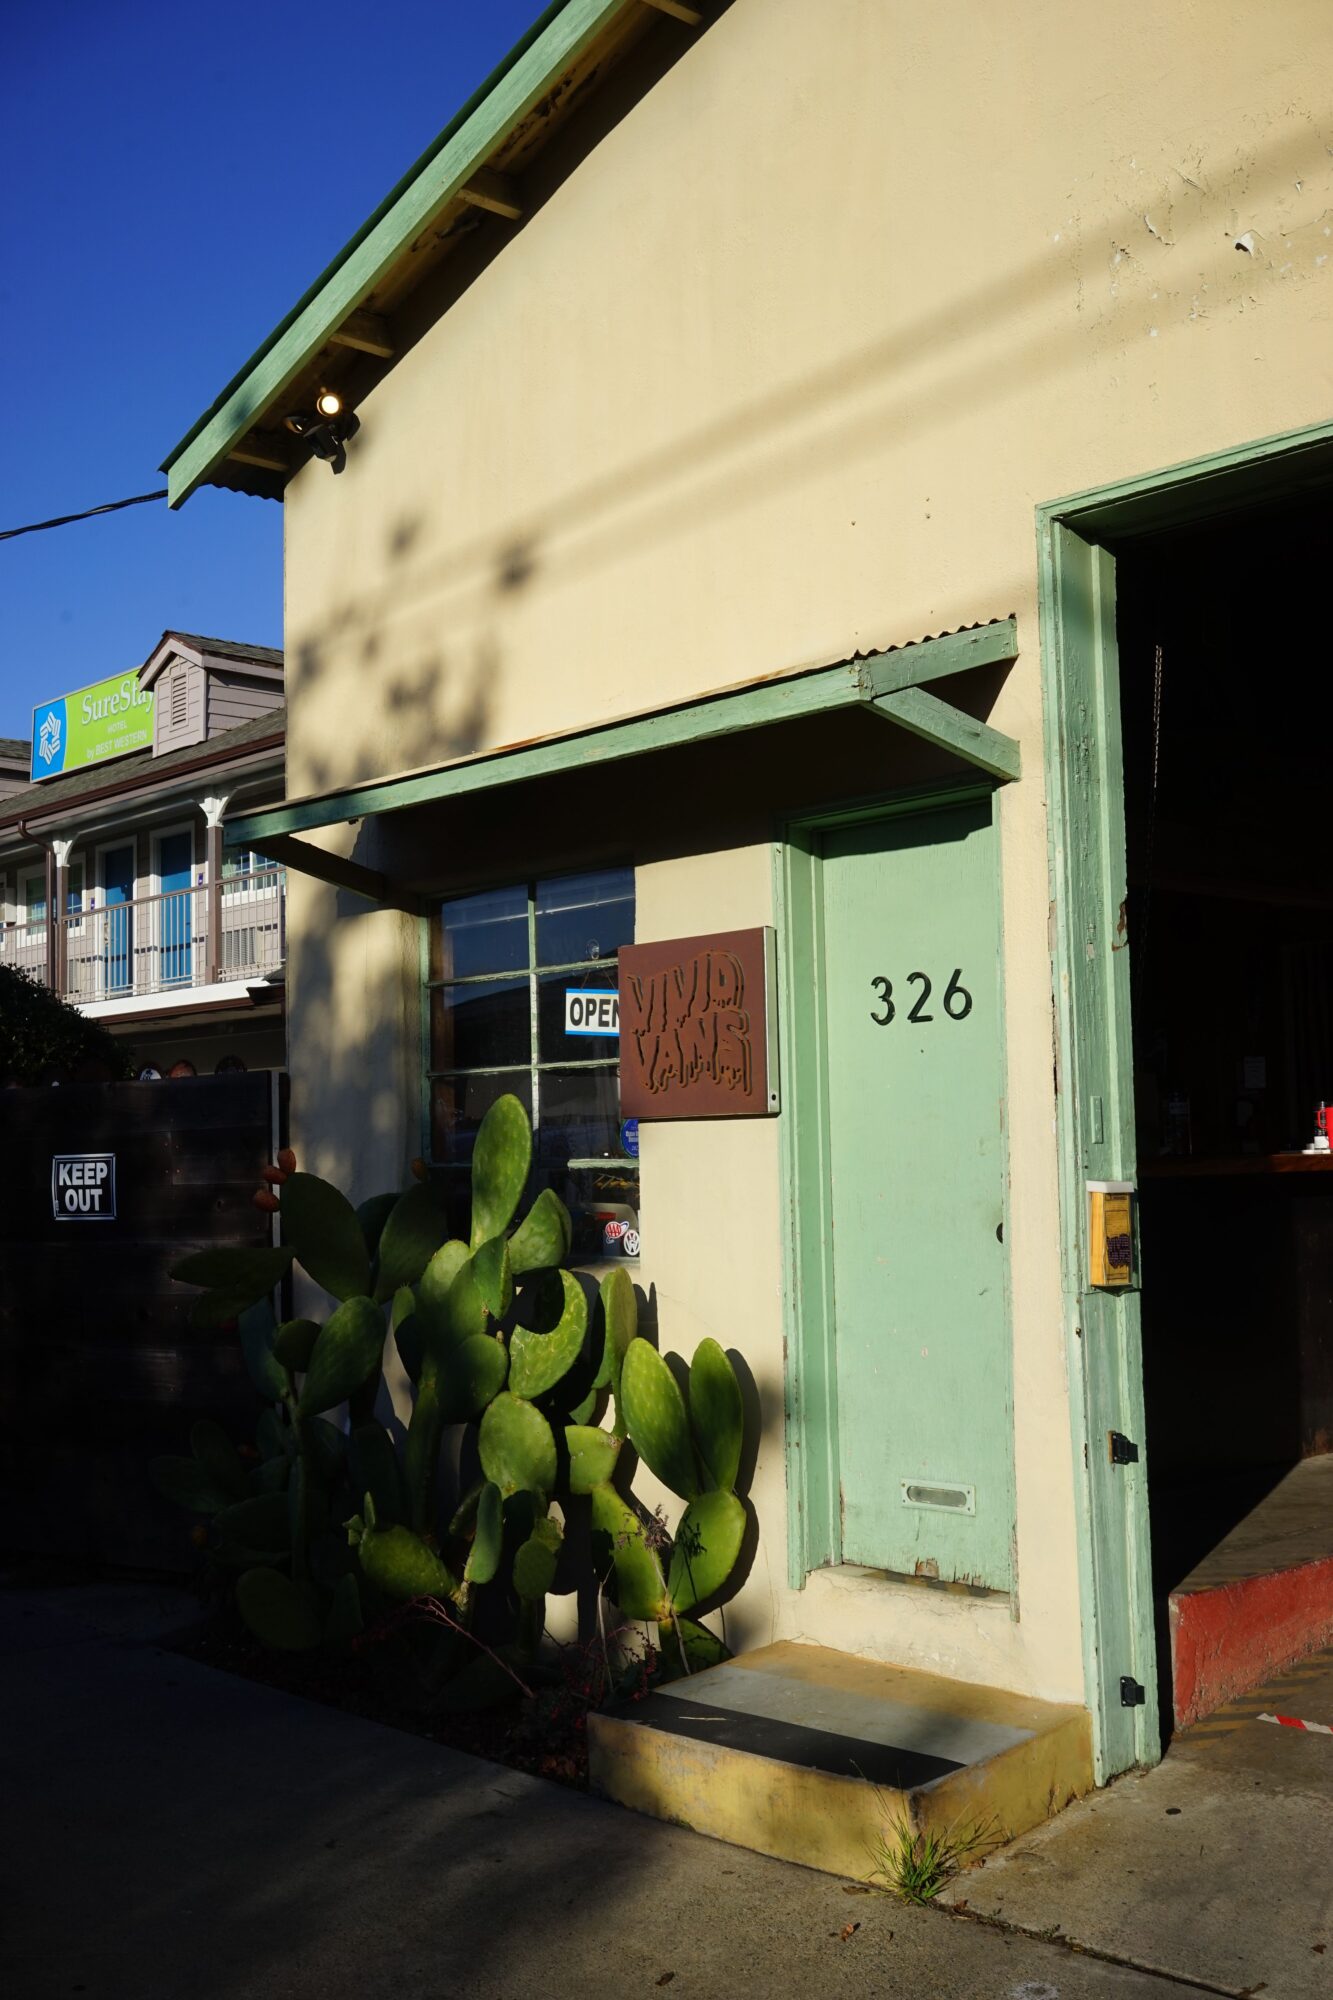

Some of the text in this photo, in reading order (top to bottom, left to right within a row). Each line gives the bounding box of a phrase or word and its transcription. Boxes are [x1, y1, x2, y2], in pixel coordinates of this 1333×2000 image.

[81, 680, 154, 725] SureStay
[95, 740, 113, 756] BEST
[113, 729, 148, 749] WESTERN
[870, 968, 973, 1026] 326
[59, 1162, 108, 1186] KEEP
[65, 1188, 103, 1212] OUT
